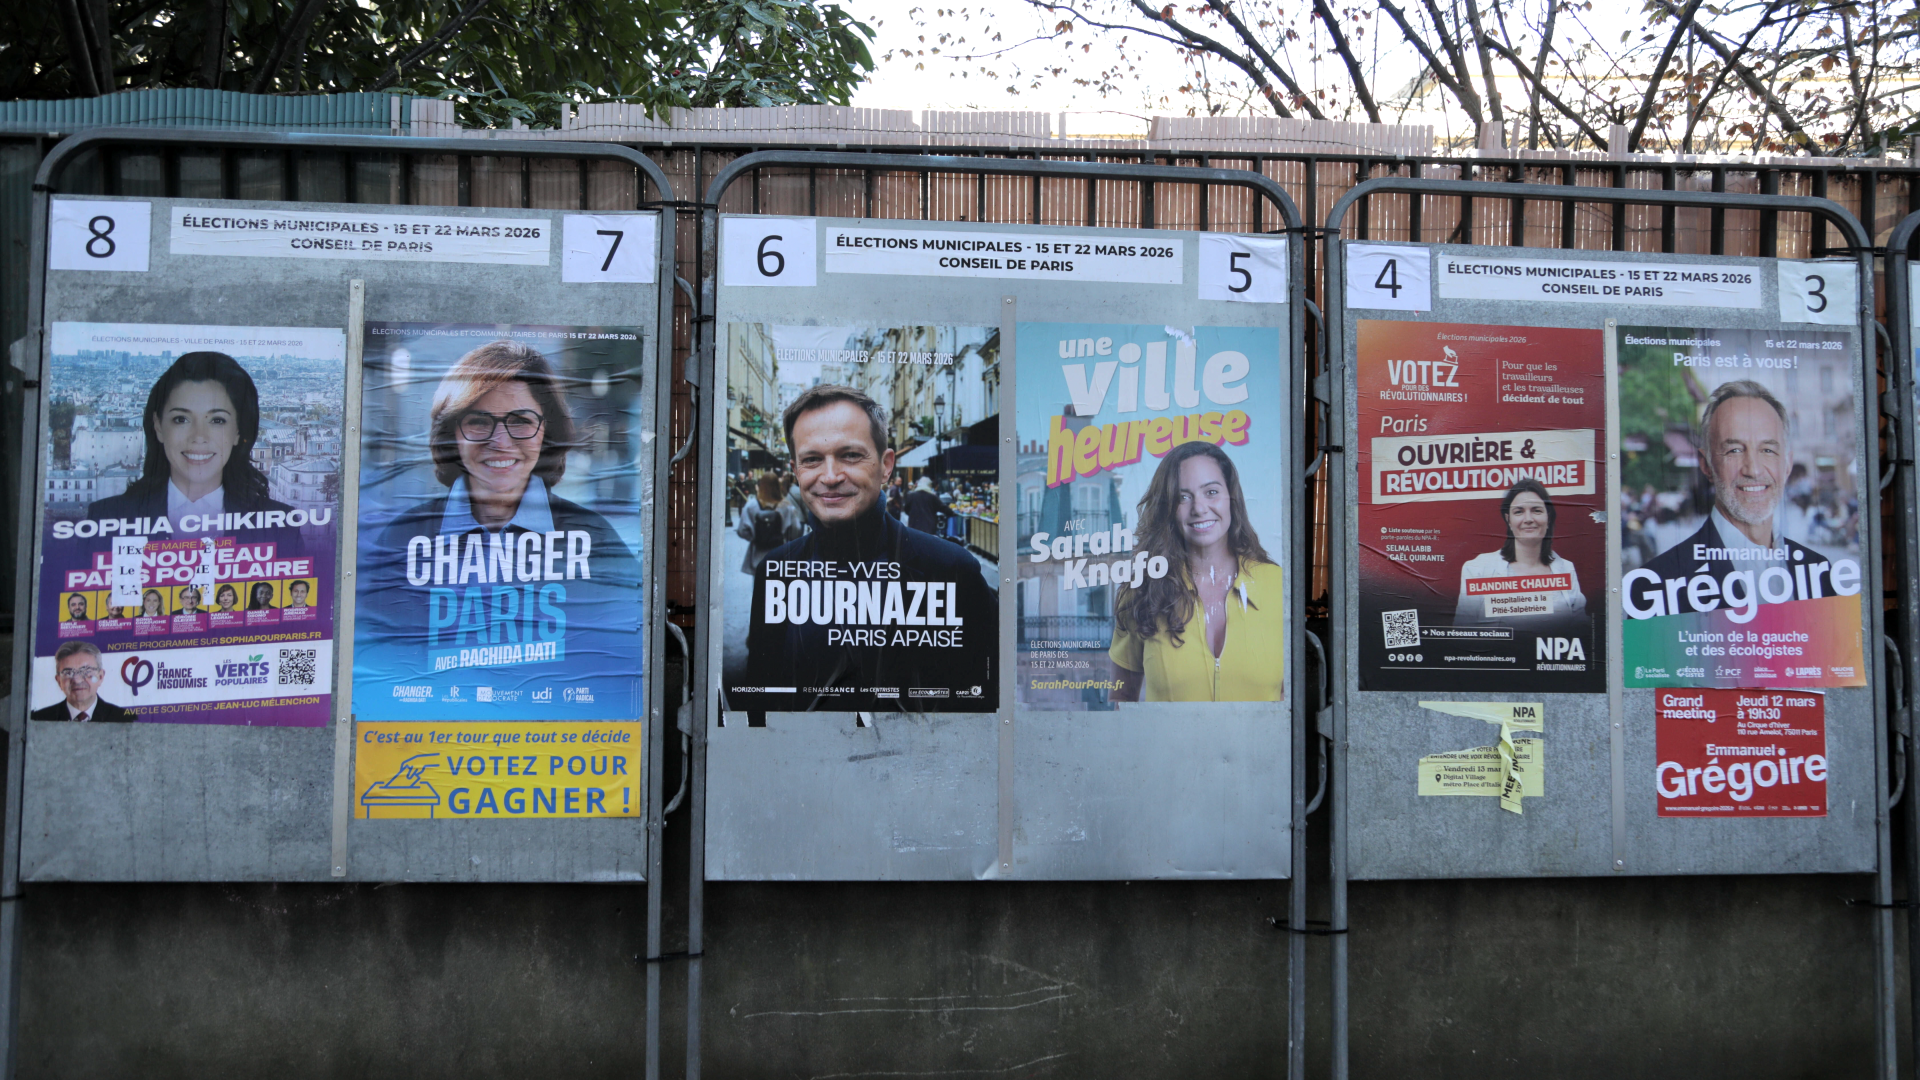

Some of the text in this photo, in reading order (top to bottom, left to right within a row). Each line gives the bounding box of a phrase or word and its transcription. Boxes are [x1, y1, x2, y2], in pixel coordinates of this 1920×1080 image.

[183, 214, 541, 239] ÉLECTIONS MUNICIPALES 15 ET 22 MARS 2026
[86, 215, 115, 258] 8
[290, 238, 433, 253] CONSEIL DE PARIS
[596, 229, 624, 272] 7
[757, 235, 785, 277] 6
[837, 234, 1174, 259] ÉLECTIONS MUNICIPALES 15 ET 22 MARS 2026
[939, 257, 1073, 273] CONSEIL DE PARIS
[1228, 251, 1252, 292] 5
[1447, 261, 1752, 285] ÉLECTIONS MUNICIPALES 15 ET 22 MARS 2026
[1374, 259, 1402, 298] 4
[1541, 283, 1663, 297] CONSEIL DE PARIS
[1805, 274, 1828, 313] 3
[777, 346, 954, 366] ÉLECTIONS MUNICIPALES 15 ET 22 MARS 2026
[1058, 336, 1113, 359] une
[1502, 360, 1558, 372] Pour que les
[1673, 353, 1710, 368] Paris
[1715, 355, 1737, 367] est
[1742, 353, 1752, 368] à
[1061, 339, 1250, 417] ville
[1387, 359, 1459, 387] VOTEZ
[1502, 372, 1553, 382] travailleurs
[1379, 389, 1463, 402] RÉVOLUTIONNAIRES
[1401, 384, 1417, 392] POUR
[1502, 383, 1584, 394] et les travailleuses
[1502, 394, 1584, 405] décident de tout
[1380, 414, 1428, 433] Paris
[1046, 409, 1251, 488] heureuse
[1397, 437, 1536, 466] OUVRIÈRE &
[1386, 464, 1578, 493] RÉVOLUTIONNAIRE
[52, 508, 331, 539] SOPHIA CHIKIROU
[1064, 519, 1085, 531] AVEC
[1030, 522, 1133, 563] Sarah
[1386, 544, 1432, 553] SELMA LABIB
[1693, 543, 1789, 561] Emmanuel
[406, 530, 592, 587] CHANGER
[765, 560, 901, 579] PIERRE-YVES
[1063, 551, 1169, 590] Knafo
[1468, 576, 1569, 592] BLANDINE CHAUVEL
[1622, 550, 1861, 624] Grégoire
[764, 579, 963, 626] BOURNAZEL
[428, 583, 567, 647] PARIS
[107, 631, 322, 651] NOTRE PROGRAMME SUR SOPHIAPOURPARIS.FR
[827, 627, 963, 647] PARIS APAISÉ
[1678, 631, 1808, 646] L'union de la gauche
[434, 641, 556, 671] AVEC RACHIDA DATI
[1536, 637, 1586, 660] NPA
[1685, 644, 1802, 659] et des écologistes
[157, 668, 193, 680] FRANCE
[215, 662, 270, 678] VERTS
[1536, 662, 1586, 671] RÉVOLUTIONNAIRES
[215, 677, 268, 687] POPULAIRES
[1030, 679, 1125, 691] SarahPourParis.fr
[531, 687, 552, 699] udi
[1663, 694, 1703, 707] Grand
[1736, 695, 1816, 707] Jeudi 12 mars
[124, 697, 321, 716] AVEC LE SOUTIEN DE JEAN-LUC MÉLENCHON
[1513, 707, 1536, 718] NPA
[1663, 708, 1716, 723] meeting
[1737, 708, 1781, 720] à 19h30
[363, 730, 631, 747] C'est au 1er tour que tout se décide
[1706, 744, 1776, 757] Emmanuel
[446, 756, 628, 776] VOTEZ POUR
[1656, 748, 1827, 802] Grégoire
[447, 787, 607, 814] GAGNER
[622, 787, 630, 814] !
